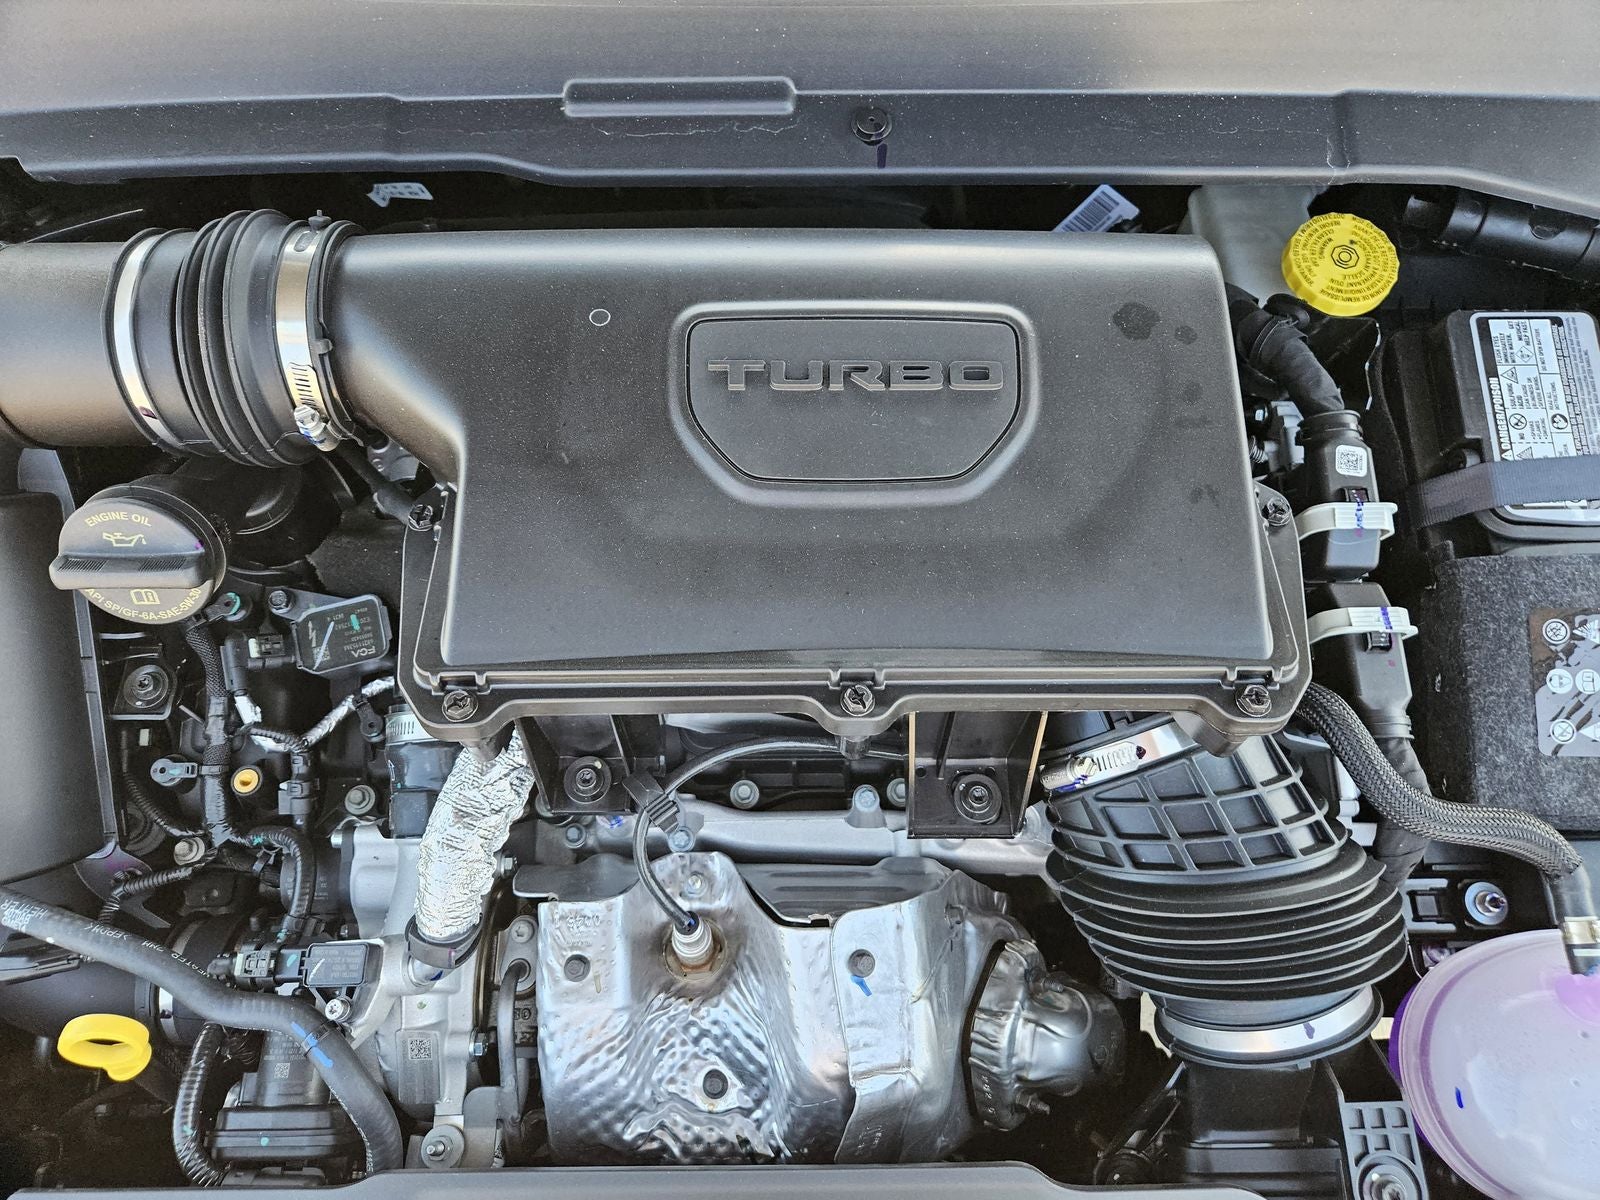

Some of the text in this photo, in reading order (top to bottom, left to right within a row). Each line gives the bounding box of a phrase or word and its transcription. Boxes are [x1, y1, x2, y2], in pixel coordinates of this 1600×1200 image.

[707, 359, 1003, 391] TURBO
[1488, 377, 1511, 449] DANGER/POISON
[84, 511, 152, 527] ENGINE OIL
[87, 588, 103, 603] API
[351, 646, 376, 658] FCA
